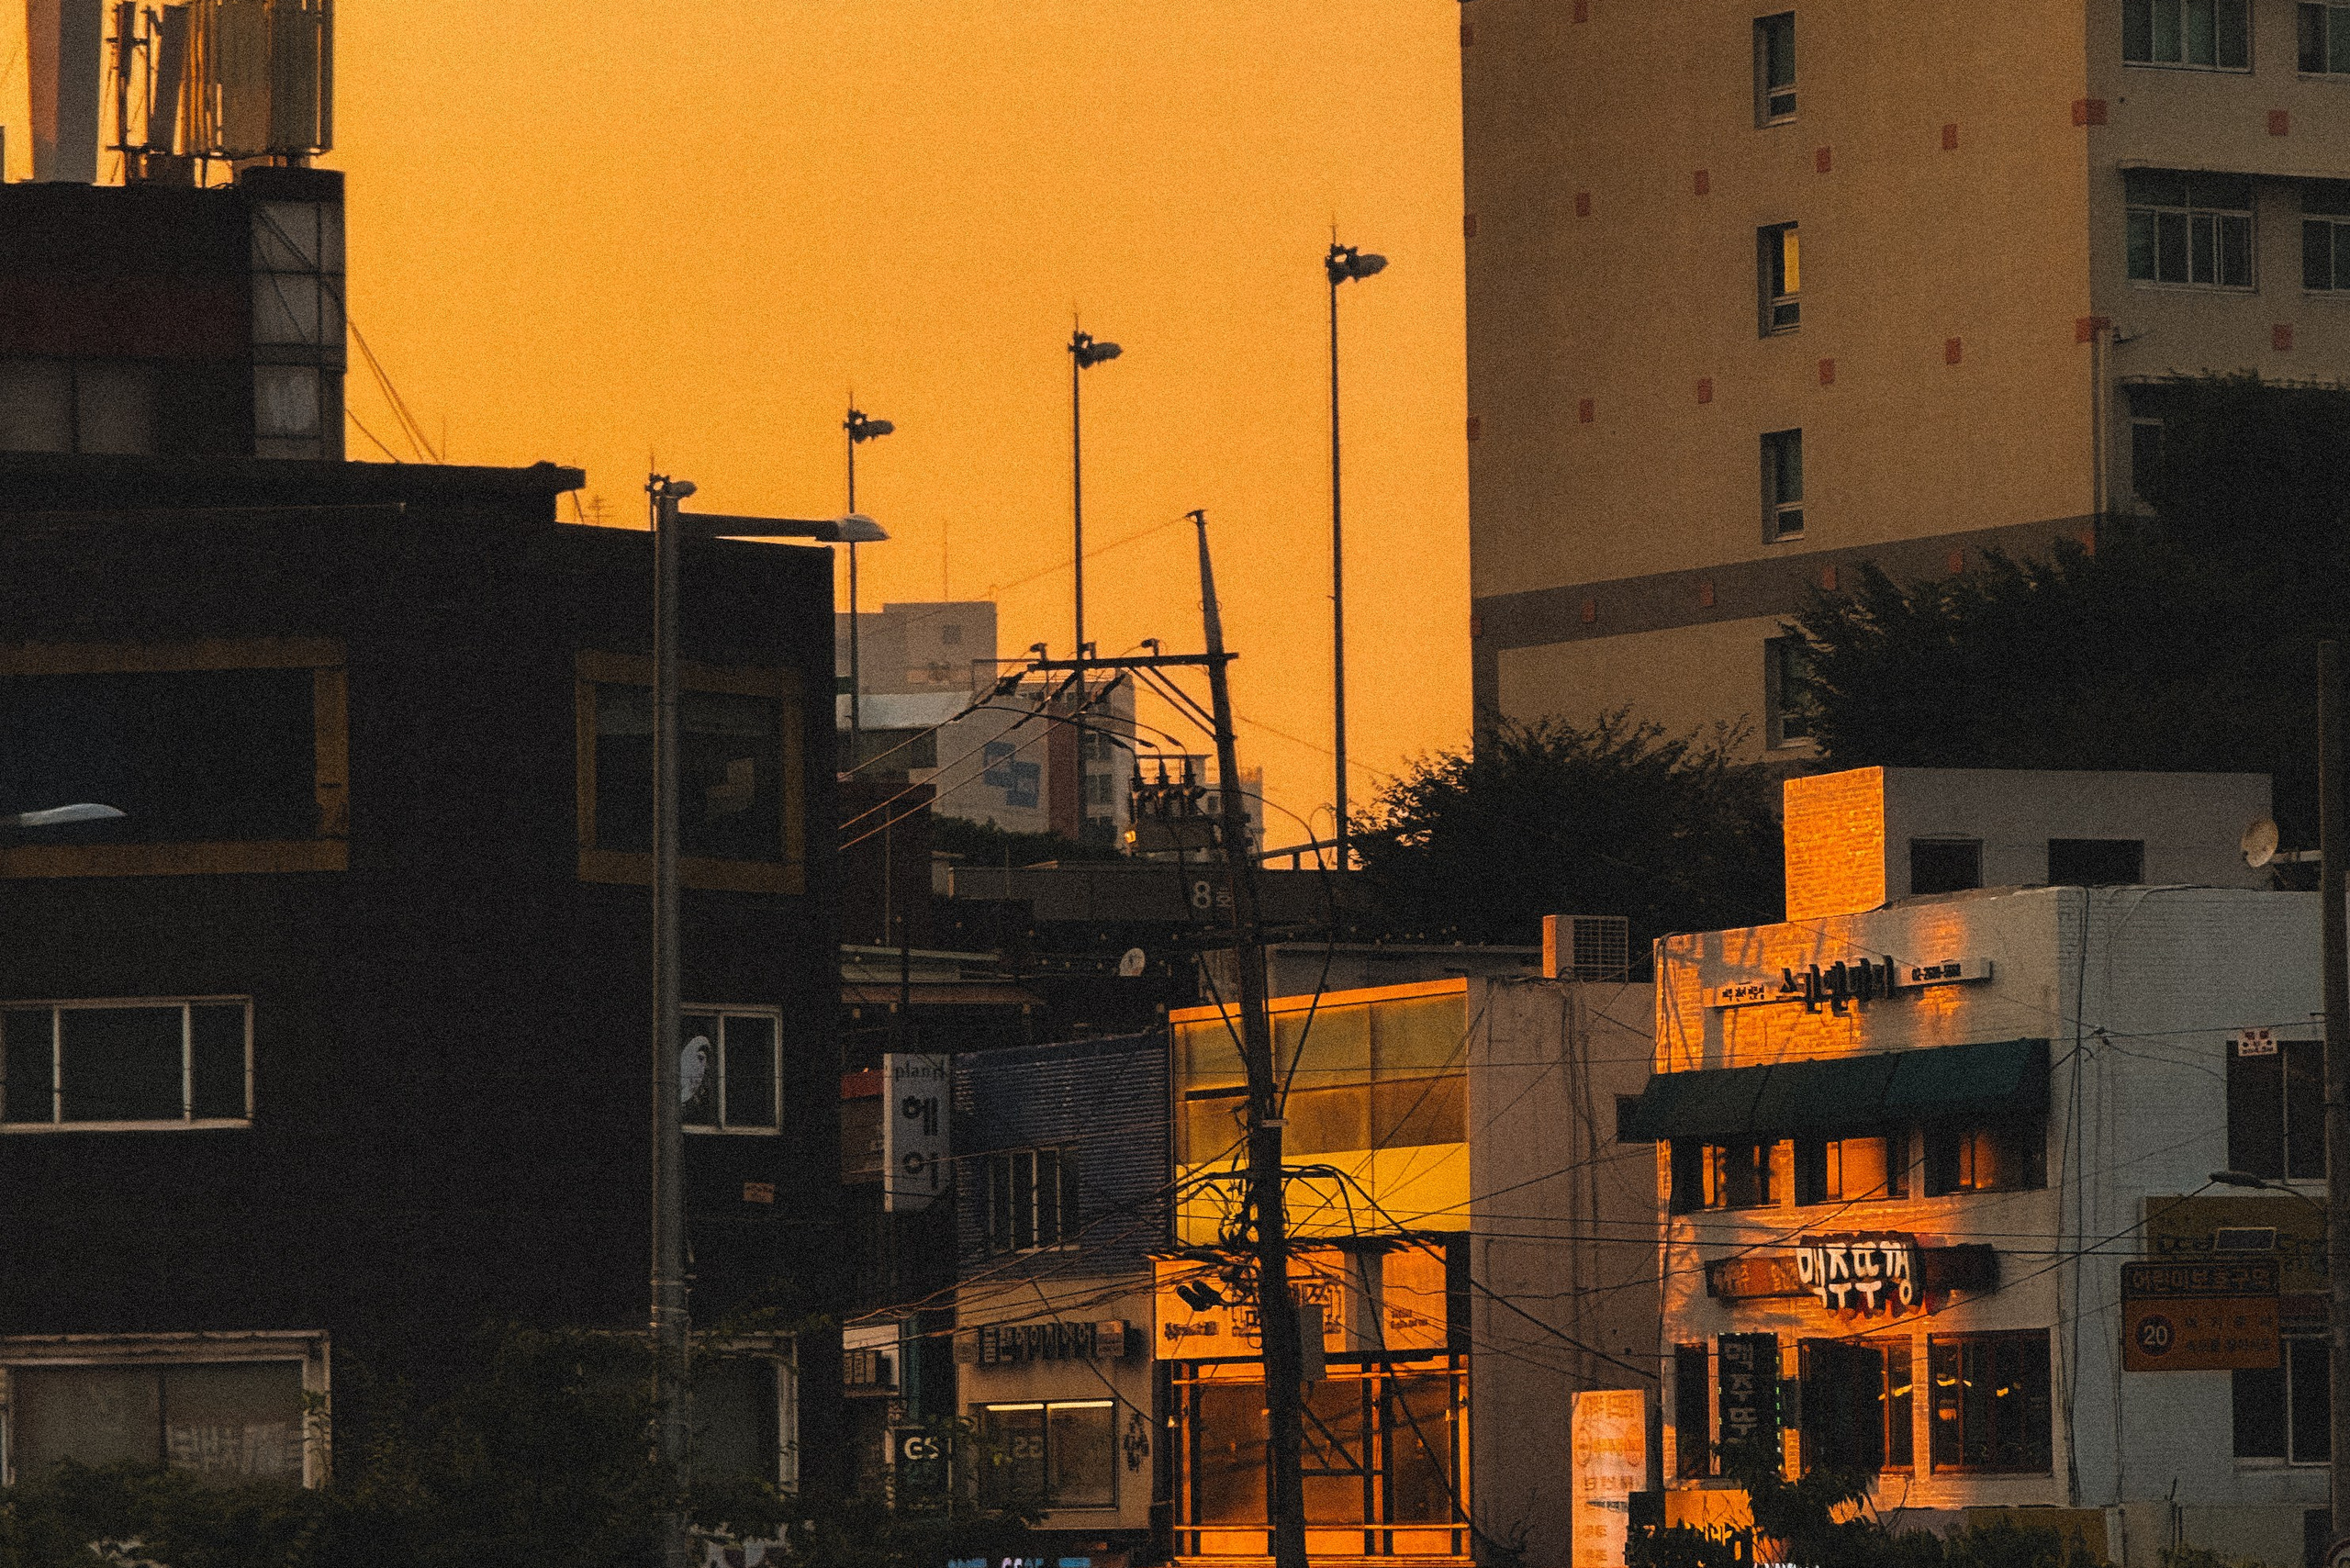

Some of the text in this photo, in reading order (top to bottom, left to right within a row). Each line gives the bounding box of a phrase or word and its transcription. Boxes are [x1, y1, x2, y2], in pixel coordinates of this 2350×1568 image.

[2132, 1267, 2272, 1292] 어린이보호구역
[2143, 1325, 2169, 1347] 20
[1724, 1342, 1759, 1443] 맥주뚜
[903, 1436, 940, 1461] GS
